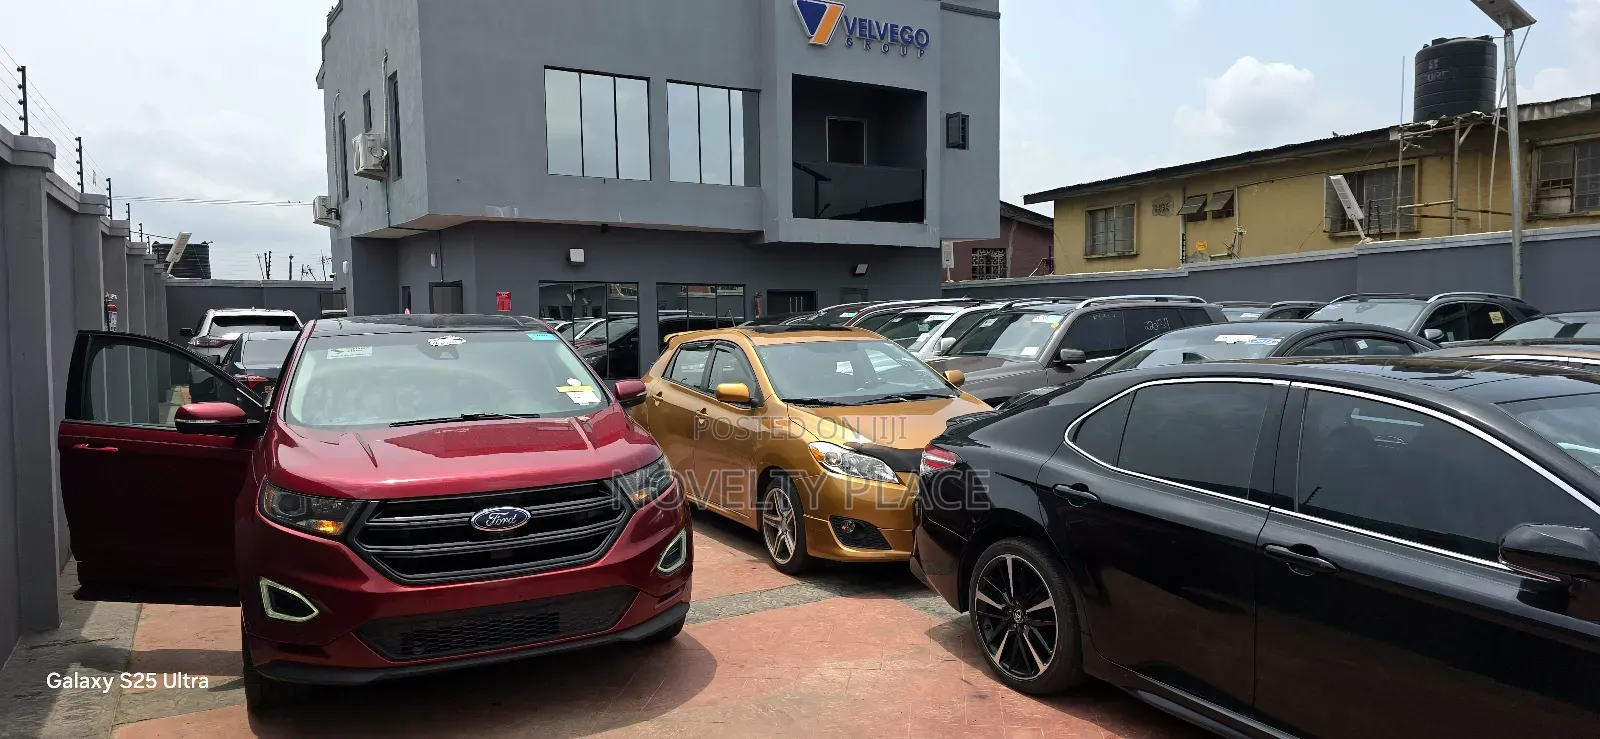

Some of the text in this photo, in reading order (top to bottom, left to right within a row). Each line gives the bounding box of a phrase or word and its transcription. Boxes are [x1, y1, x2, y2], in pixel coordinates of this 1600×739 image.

[843, 15, 930, 48] VELVEGO
[845, 37, 925, 58] GROUP
[485, 511, 518, 526] Ford
